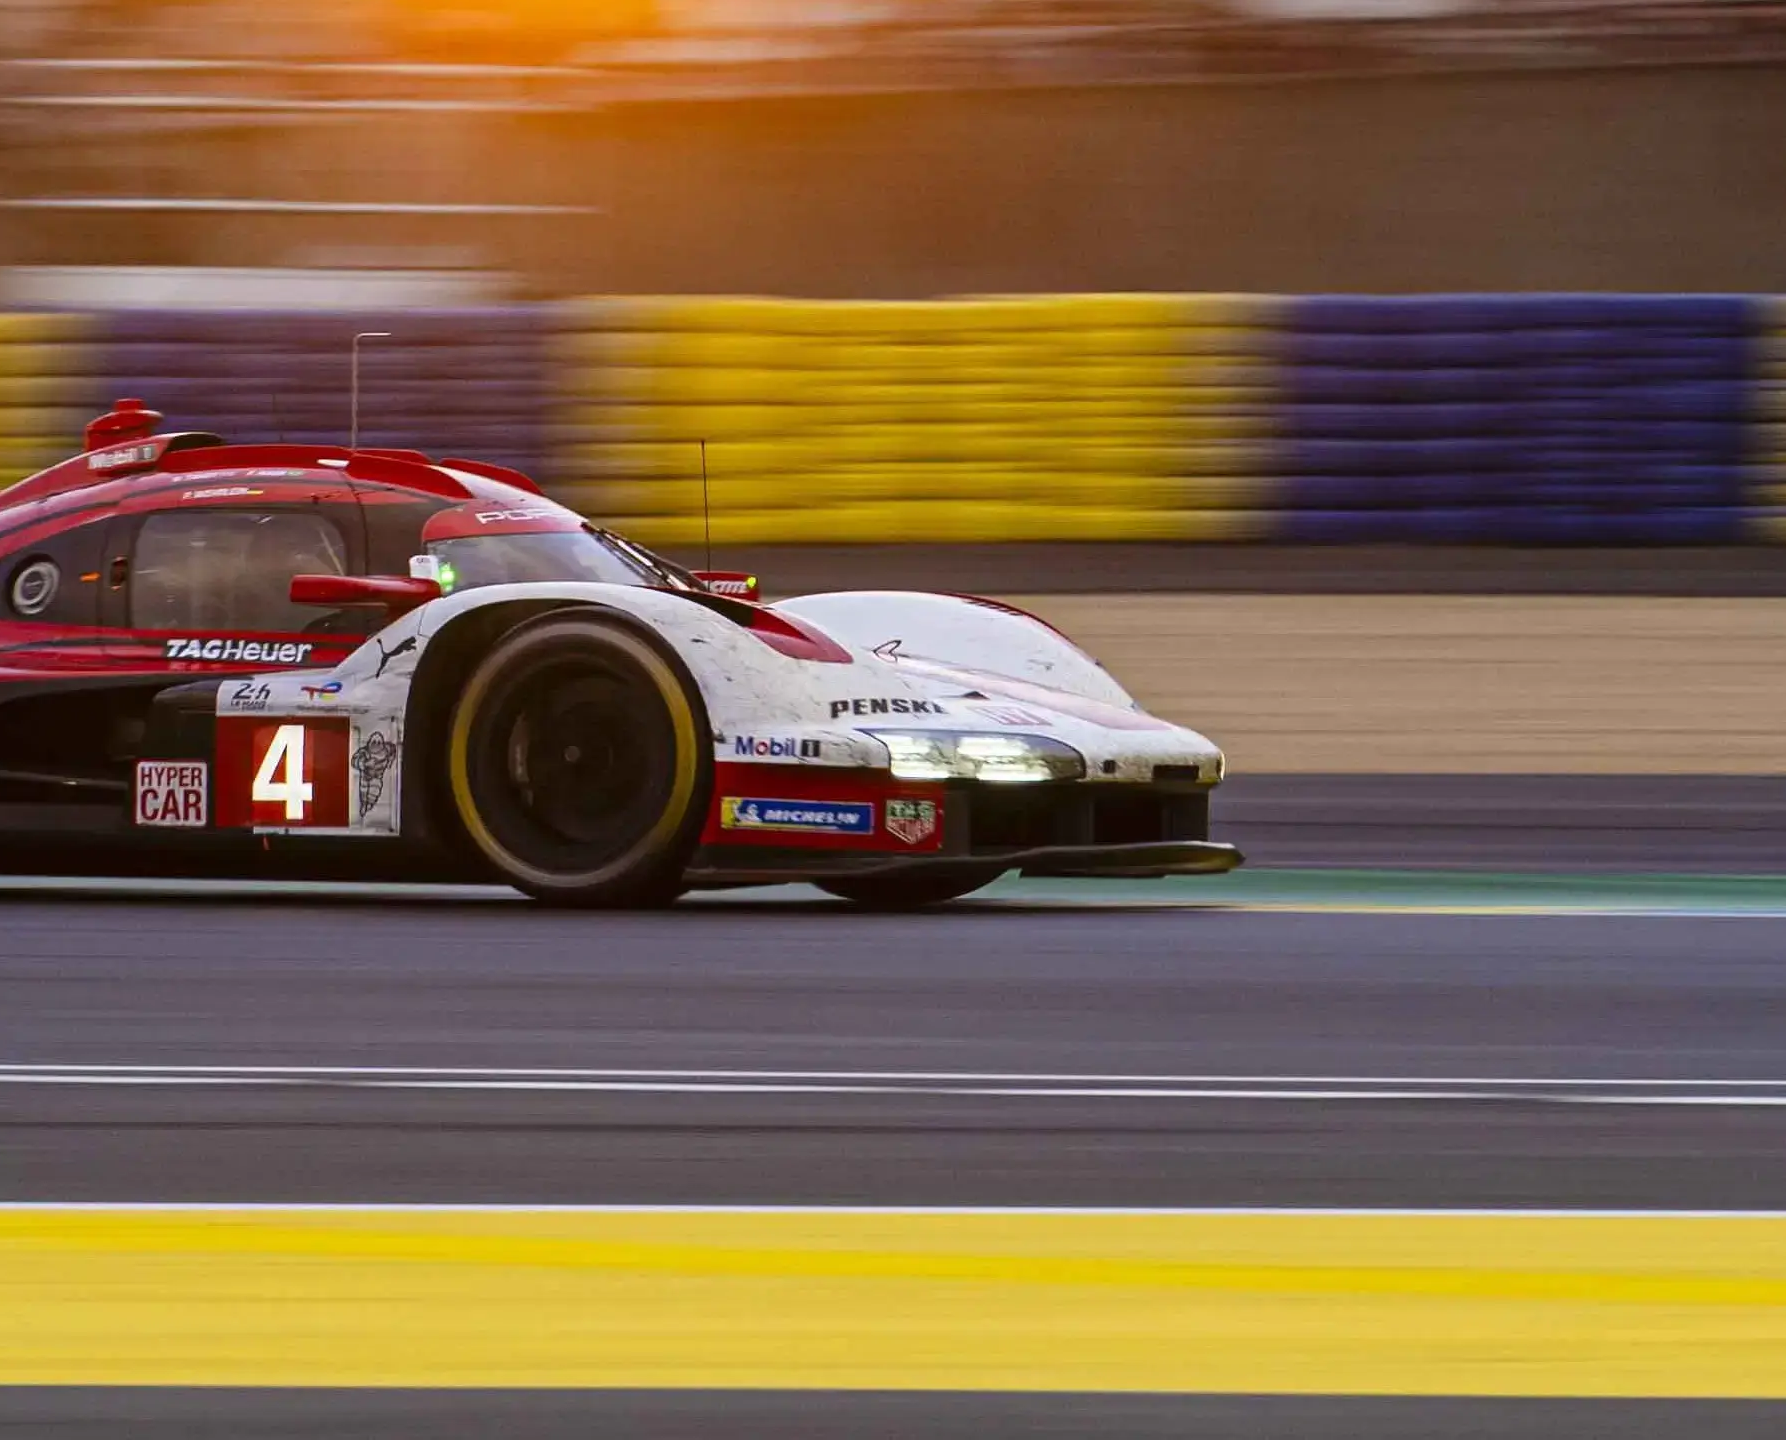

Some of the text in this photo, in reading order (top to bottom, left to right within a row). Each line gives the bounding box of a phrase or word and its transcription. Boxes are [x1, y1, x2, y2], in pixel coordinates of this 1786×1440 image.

[166, 639, 313, 663] TAGHeuer
[735, 735, 819, 757] Mobil 1
[140, 767, 203, 787] HYPER
[252, 725, 313, 820] 4
[140, 789, 203, 821] CAR
[762, 808, 862, 825] MICHELIN
